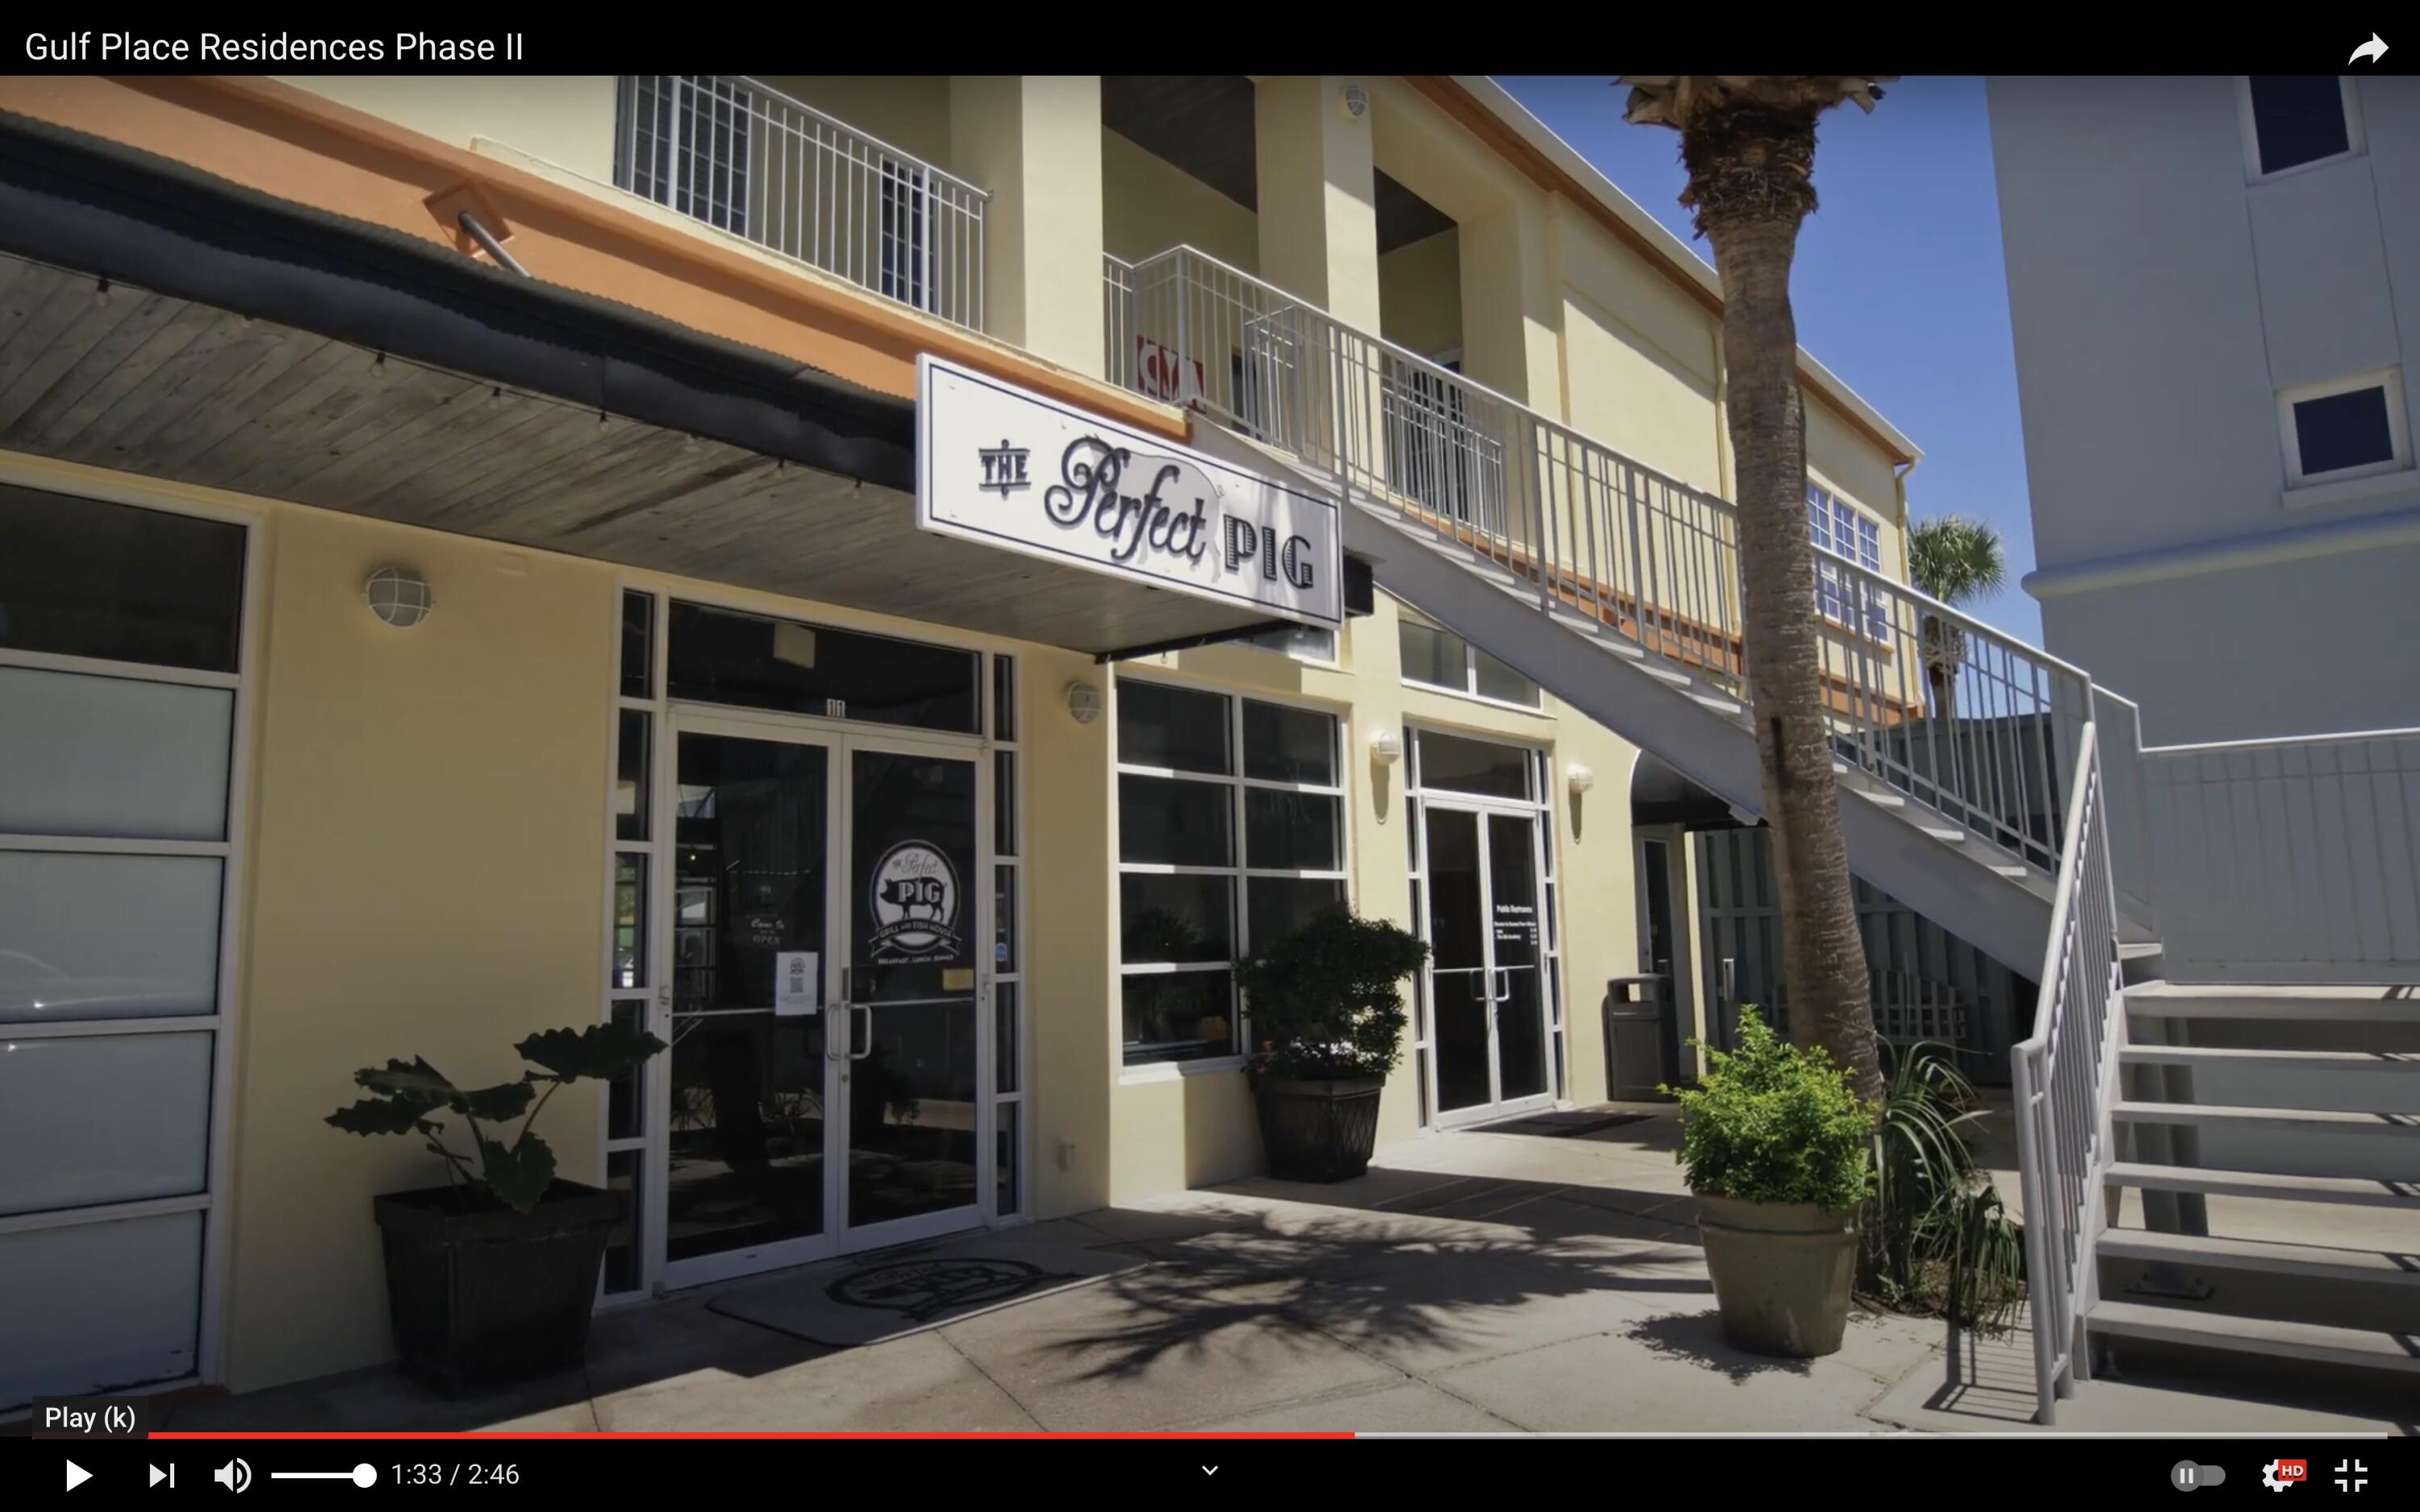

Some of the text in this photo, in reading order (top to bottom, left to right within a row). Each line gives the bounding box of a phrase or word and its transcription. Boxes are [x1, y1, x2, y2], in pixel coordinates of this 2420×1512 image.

[979, 435, 1314, 589] THE Perfect PIG
[899, 882, 941, 903] PIG
[912, 921, 928, 930] FISH
